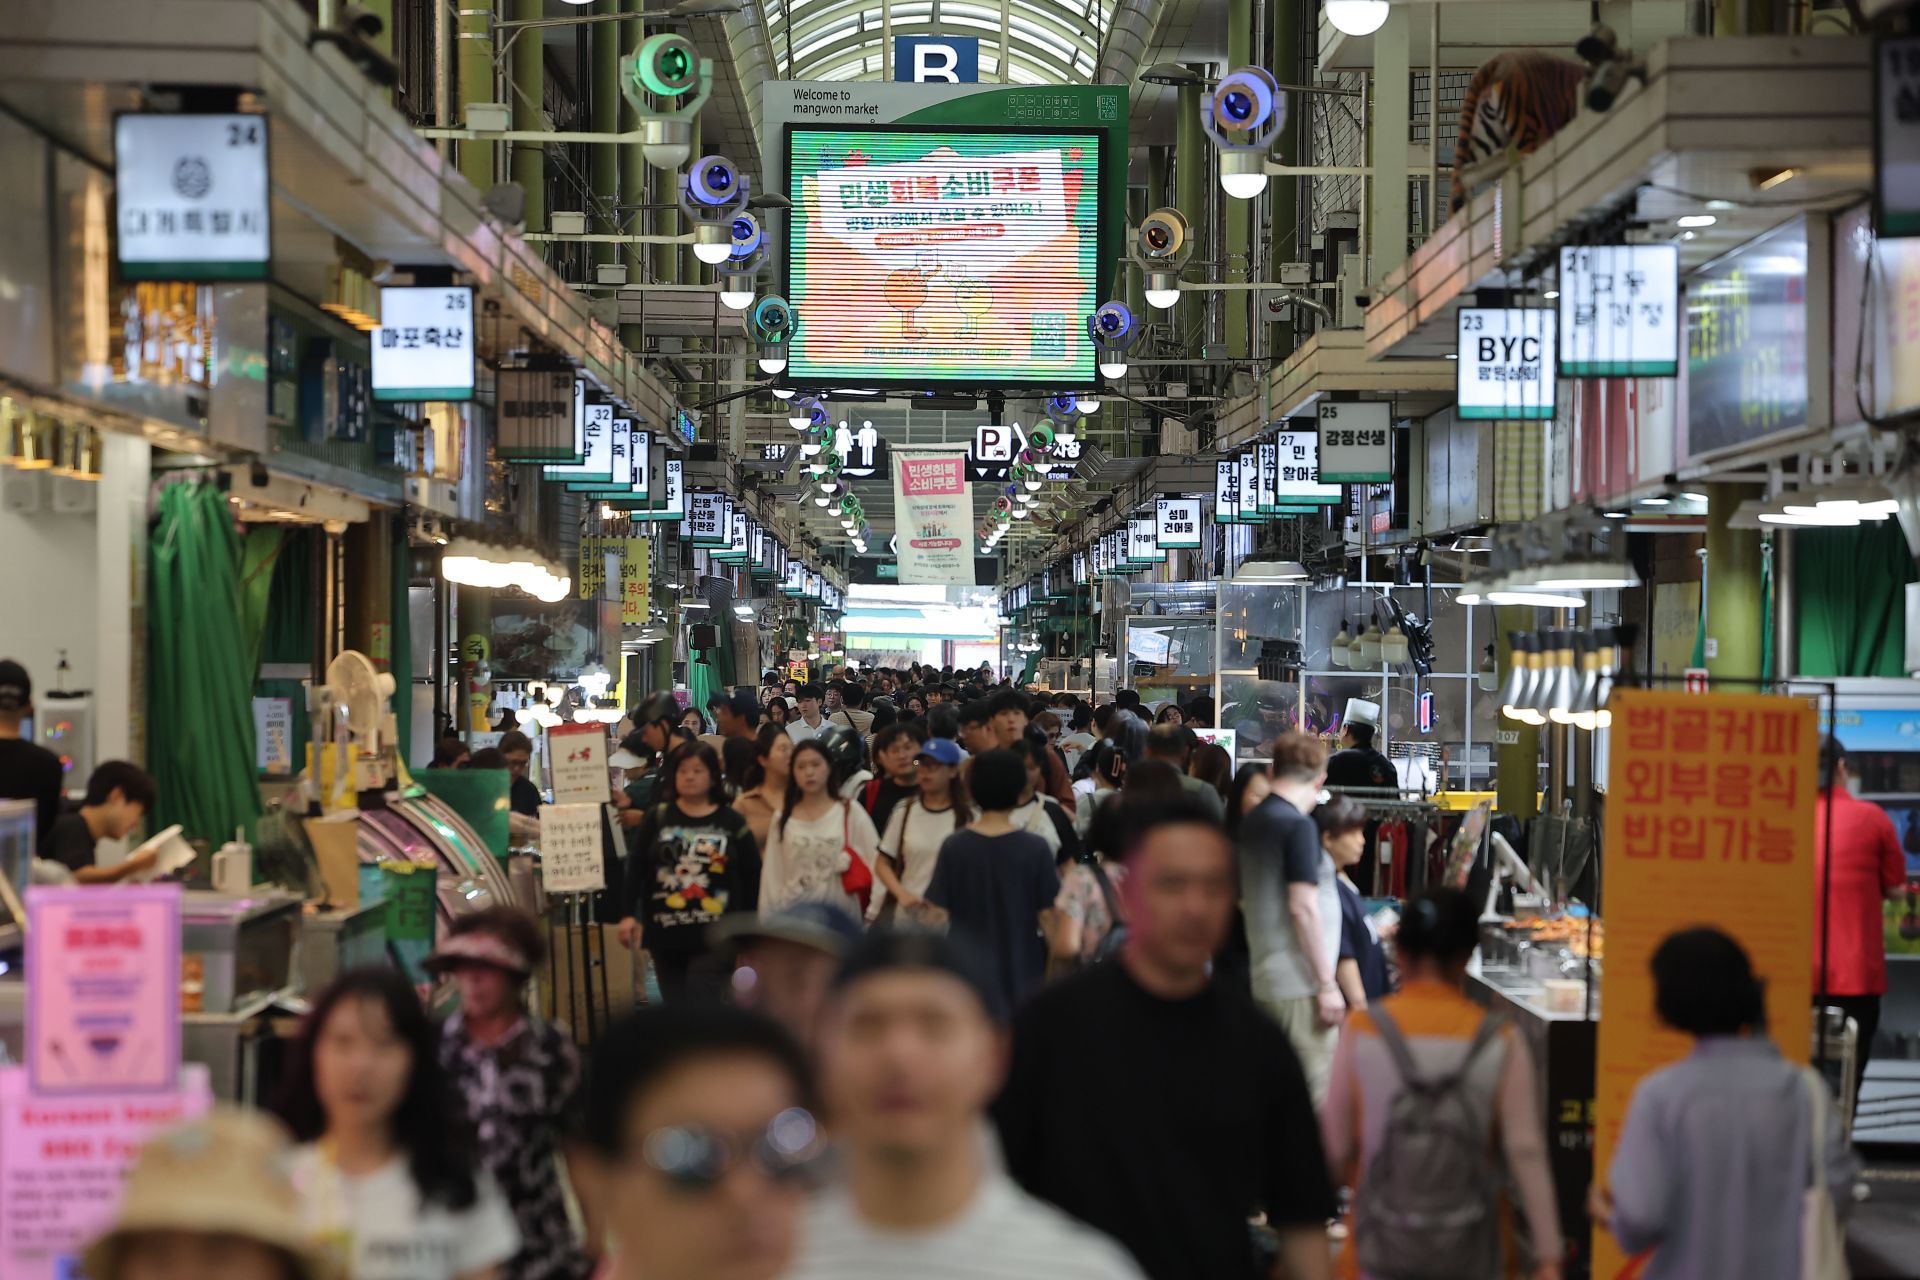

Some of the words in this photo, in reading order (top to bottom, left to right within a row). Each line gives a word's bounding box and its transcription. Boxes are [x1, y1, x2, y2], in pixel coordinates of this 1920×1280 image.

[914, 44, 960, 83] B
[794, 89, 838, 101] Welcome
[841, 90, 851, 101] to
[794, 104, 842, 117] mangwon
[845, 103, 879, 115] market
[227, 123, 258, 146] 24
[840, 166, 1041, 210] 민생회복소비쿠폰
[446, 295, 465, 310] 26
[1464, 315, 1483, 330] 23
[382, 327, 463, 349] 마포축산
[1478, 337, 1539, 362] BYC
[595, 409, 610, 420] 32
[1321, 407, 1337, 418] 25
[613, 423, 628, 433] 34
[632, 434, 646, 444] 36
[982, 429, 1001, 457] P
[1280, 435, 1294, 446] 27
[1326, 430, 1386, 446] 강정선생
[668, 463, 680, 472] 38
[1242, 458, 1254, 467] 31
[908, 463, 956, 478] 민생회복
[1219, 465, 1231, 474] 33
[1047, 472, 1069, 480] STORE
[909, 477, 958, 491] 소비쿠폰
[713, 496, 723, 504] 40
[1158, 502, 1168, 510] 37
[1168, 509, 1188, 520] 성미
[688, 521, 715, 532] 직판장
[1129, 521, 1138, 529] 39
[1164, 522, 1193, 533] 건어물
[628, 582, 646, 597] 주의
[1624, 760, 1799, 810] 외부음식
[1622, 815, 1797, 864] 반입가능
